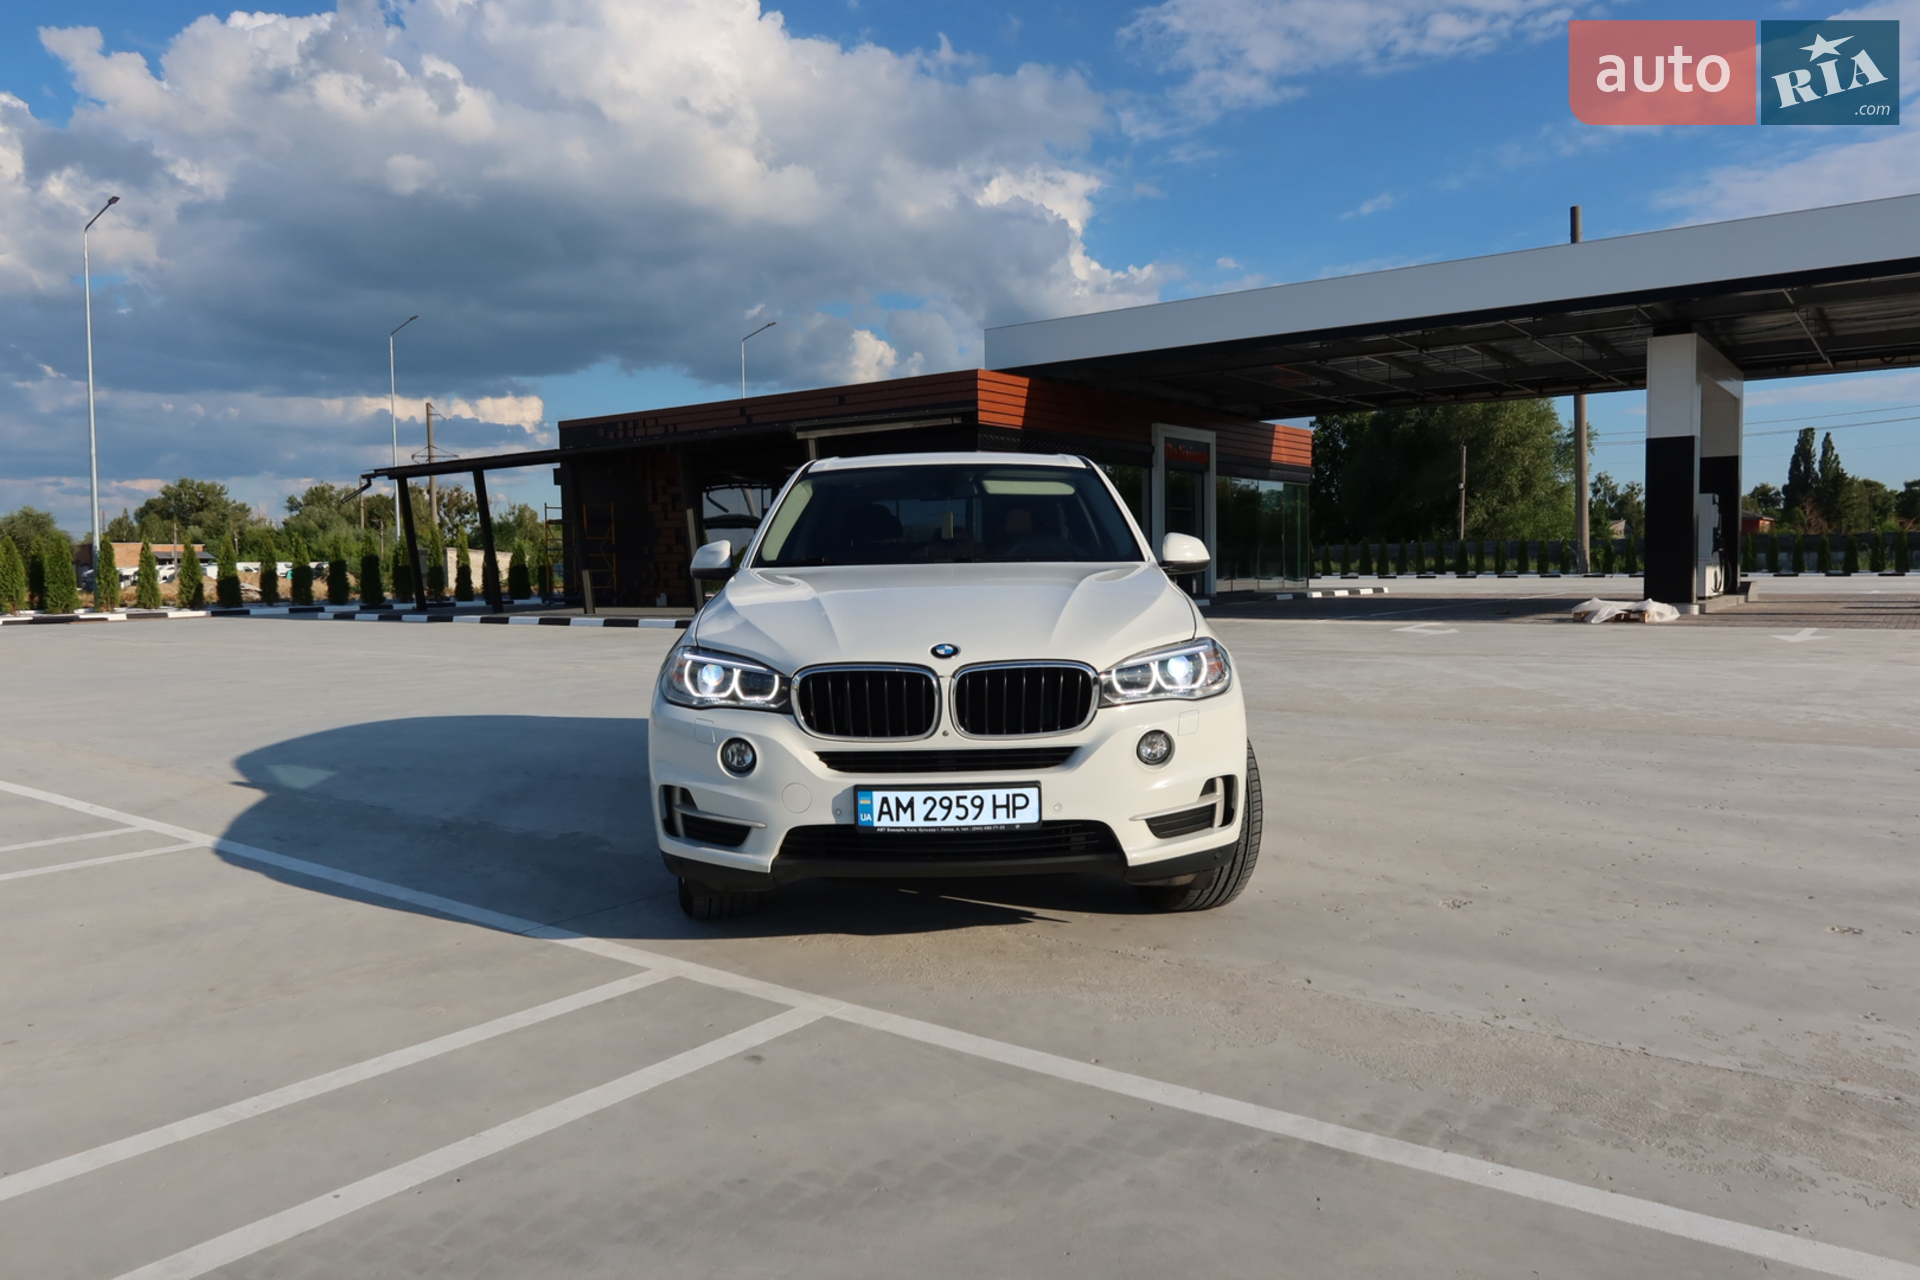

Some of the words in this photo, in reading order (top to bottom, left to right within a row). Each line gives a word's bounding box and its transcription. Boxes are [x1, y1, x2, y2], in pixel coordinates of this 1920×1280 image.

[877, 796, 915, 822] AM
[922, 795, 985, 821] 2959
[992, 793, 1030, 819] HP
[860, 813, 873, 821] UA
